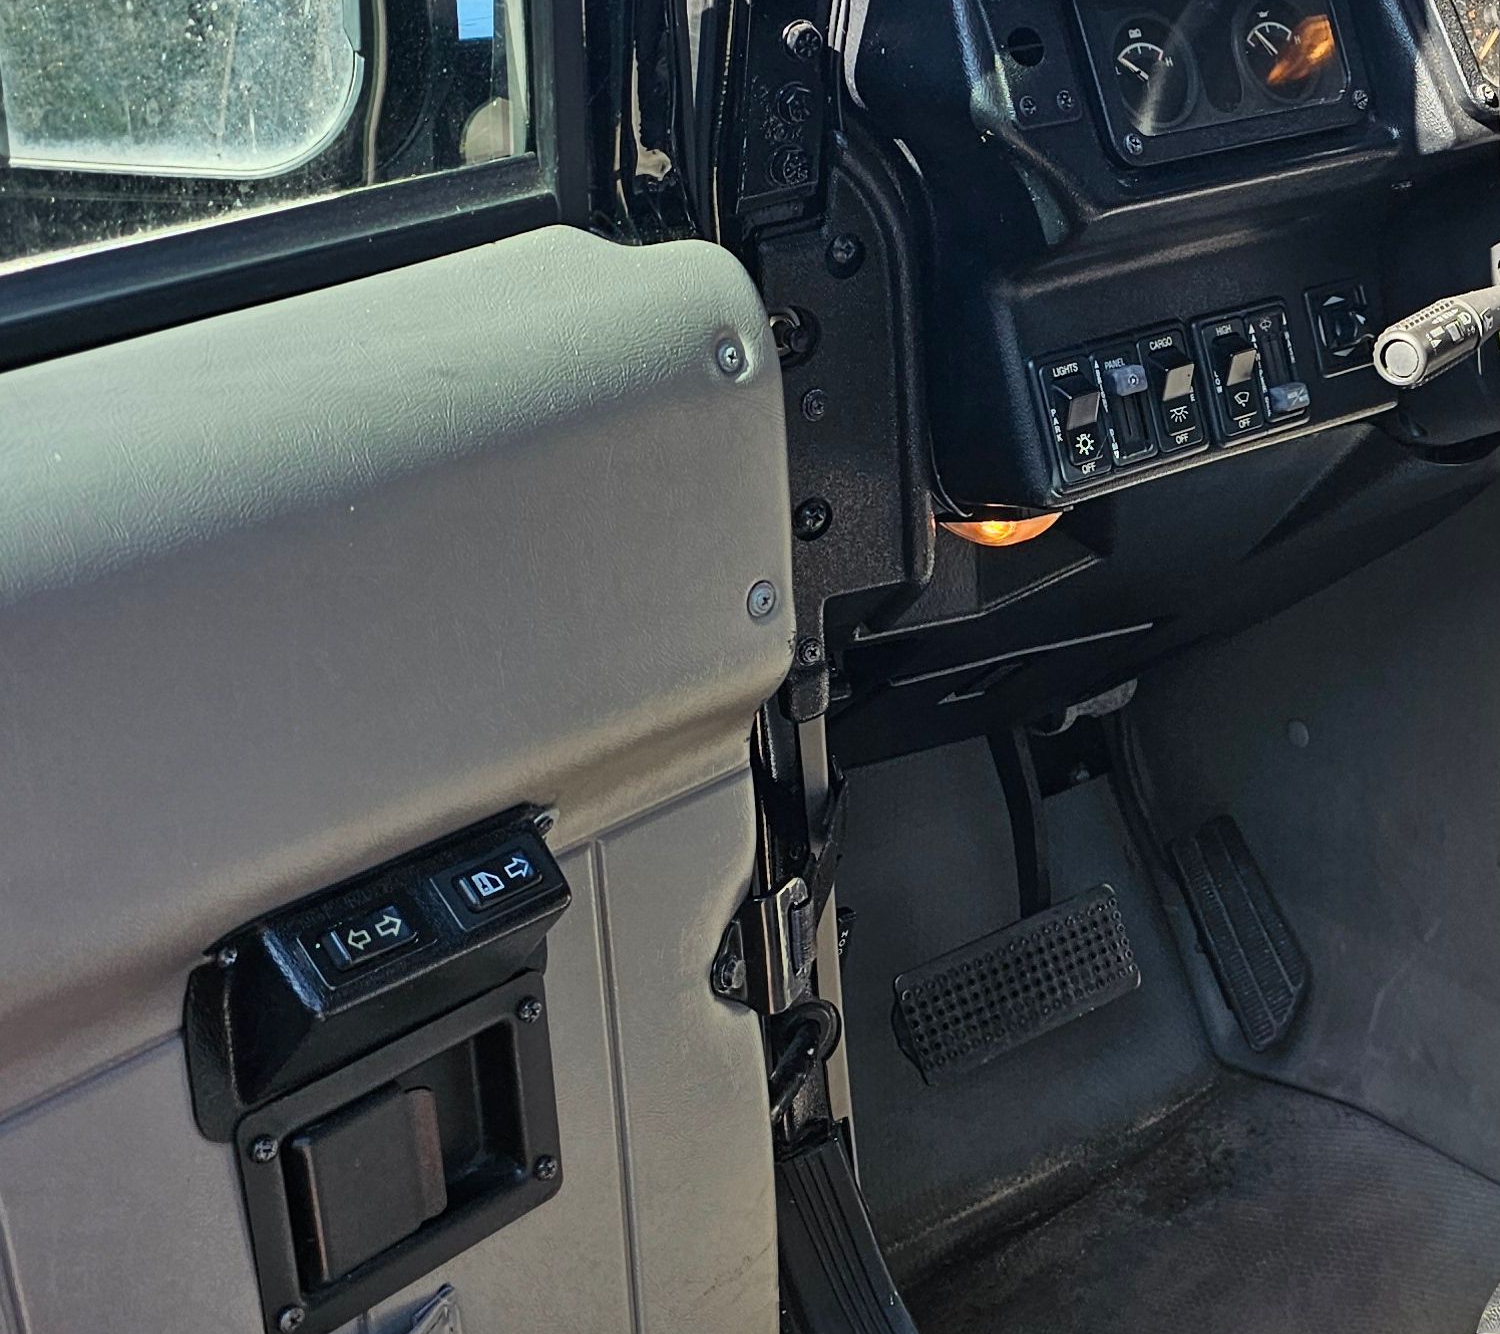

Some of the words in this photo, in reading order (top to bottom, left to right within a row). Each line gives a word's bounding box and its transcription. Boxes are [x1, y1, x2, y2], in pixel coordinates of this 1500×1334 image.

[1215, 323, 1232, 337] HIGH
[1149, 336, 1173, 351] CARGO
[1052, 362, 1079, 378] LIGHTS
[1104, 357, 1126, 370] PANEL
[1050, 408, 1064, 443] PARK
[1238, 417, 1252, 429] OFF
[1175, 433, 1190, 445] OFF
[1081, 462, 1097, 475] OFF
